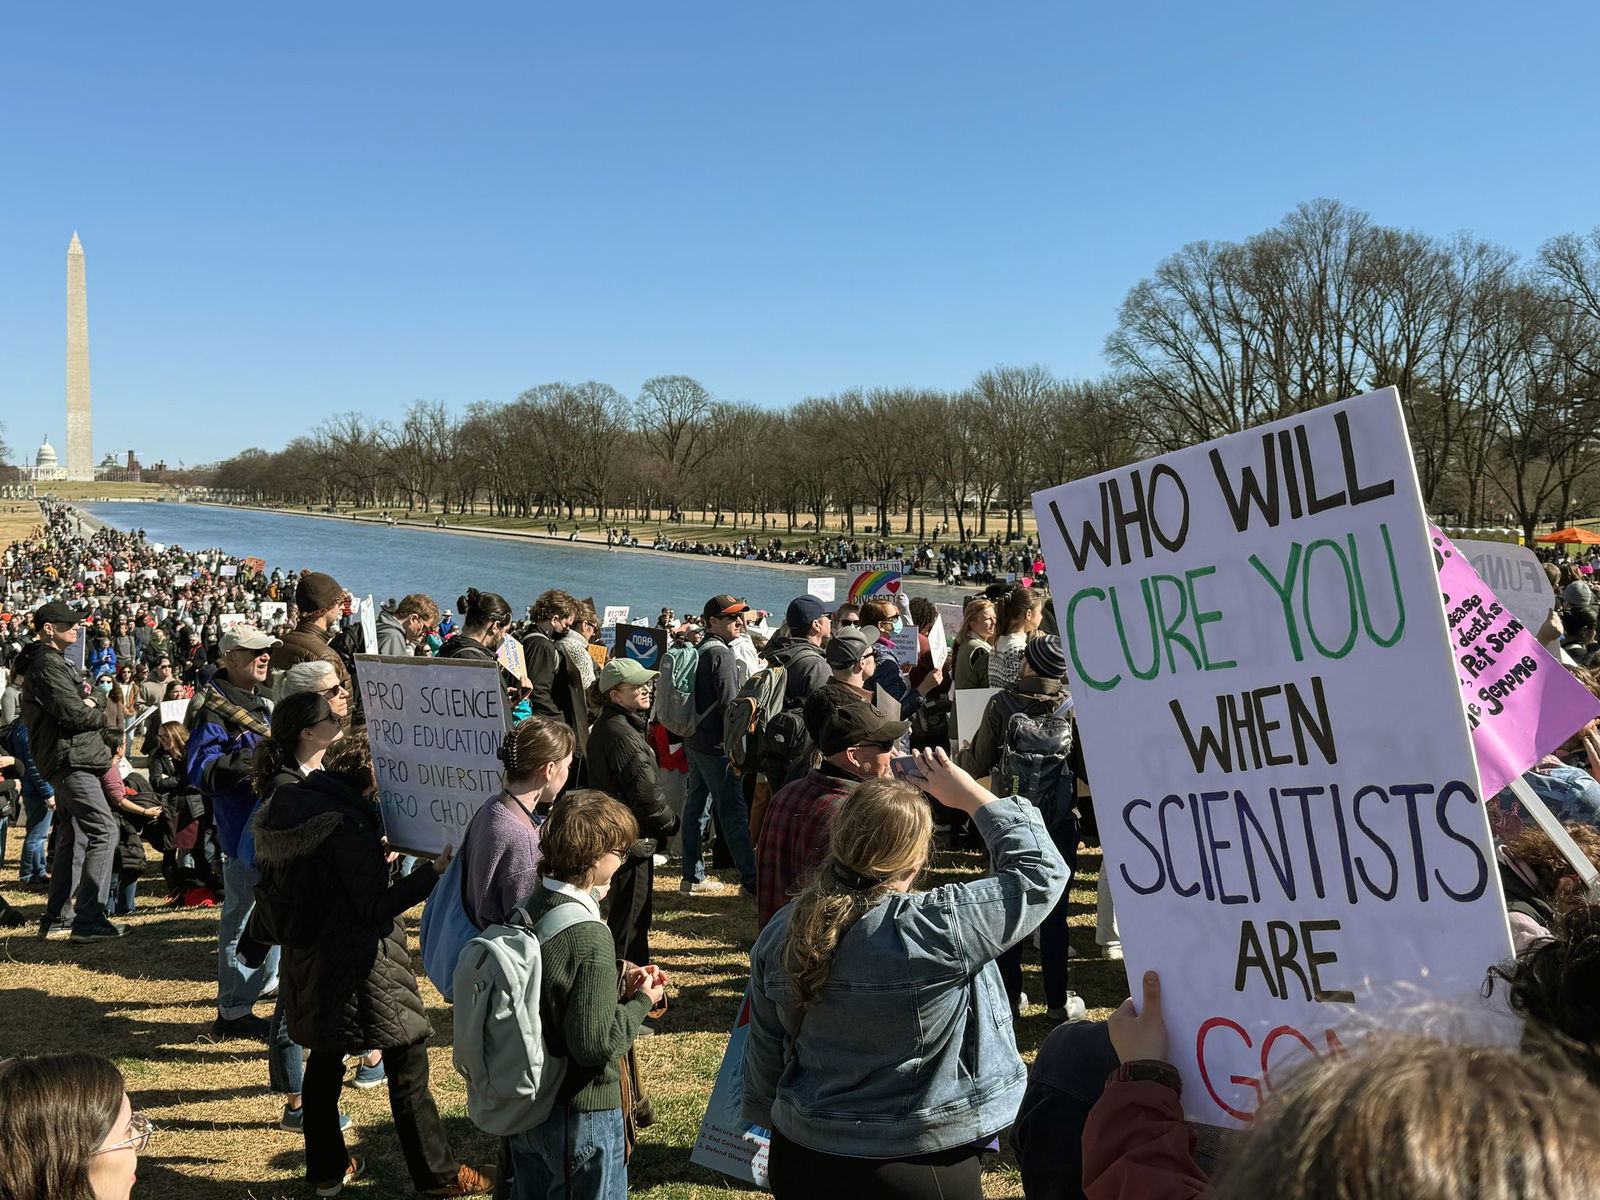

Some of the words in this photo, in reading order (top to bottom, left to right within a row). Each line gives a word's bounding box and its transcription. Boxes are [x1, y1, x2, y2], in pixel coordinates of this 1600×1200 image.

[1049, 463, 1190, 572] WHO
[1208, 410, 1395, 533] WILL
[850, 563, 889, 572] STRENGTH
[891, 562, 900, 572] IN
[1065, 565, 1238, 692] CURE
[1247, 523, 1406, 663] YOU
[1447, 594, 1483, 632] sease
[1458, 602, 1504, 648] deaths
[1460, 645, 1497, 680] Pet
[1485, 618, 1525, 654] Scan
[367, 681, 404, 711] PRO
[420, 686, 498, 719] SCIENCE
[1478, 655, 1539, 716] genome
[371, 719, 403, 745] PRO
[414, 725, 501, 755] EDUCATION
[1168, 676, 1338, 774] WHEN
[377, 756, 409, 783] PRO
[417, 763, 506, 793] DIVERSITY
[383, 789, 418, 818] PRO
[430, 799, 475, 826] CHOI
[1119, 780, 1489, 905] SCIENTISTS
[1234, 919, 1356, 1004] ARE
[1196, 1017, 1356, 1122] GO
[705, 1145, 727, 1156] Defend
[708, 1135, 720, 1143] End
[721, 1139, 756, 1156] Censorship
